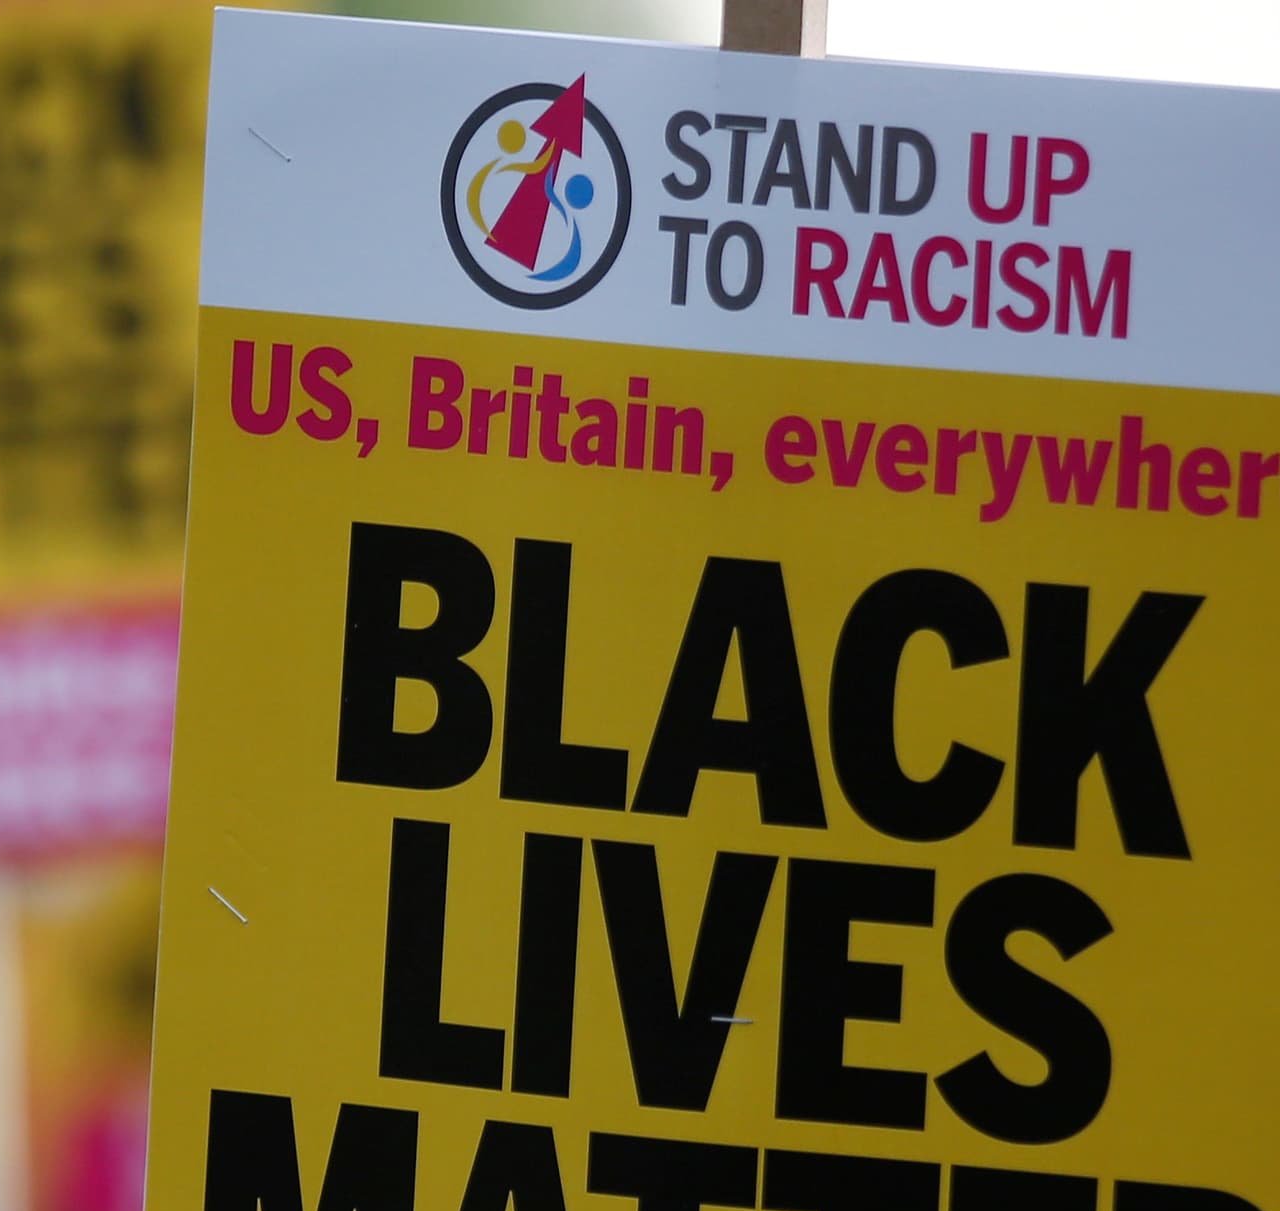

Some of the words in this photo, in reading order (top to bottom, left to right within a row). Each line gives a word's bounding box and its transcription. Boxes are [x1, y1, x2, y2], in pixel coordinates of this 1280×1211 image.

[660, 109, 938, 217] STAND
[966, 131, 1091, 226] UP
[657, 214, 766, 312] TO
[791, 225, 1133, 340] RACISM
[230, 339, 381, 459] US,
[407, 355, 736, 493] Britain,
[334, 520, 1208, 862] BLACK
[377, 816, 1115, 1147] LIVES
